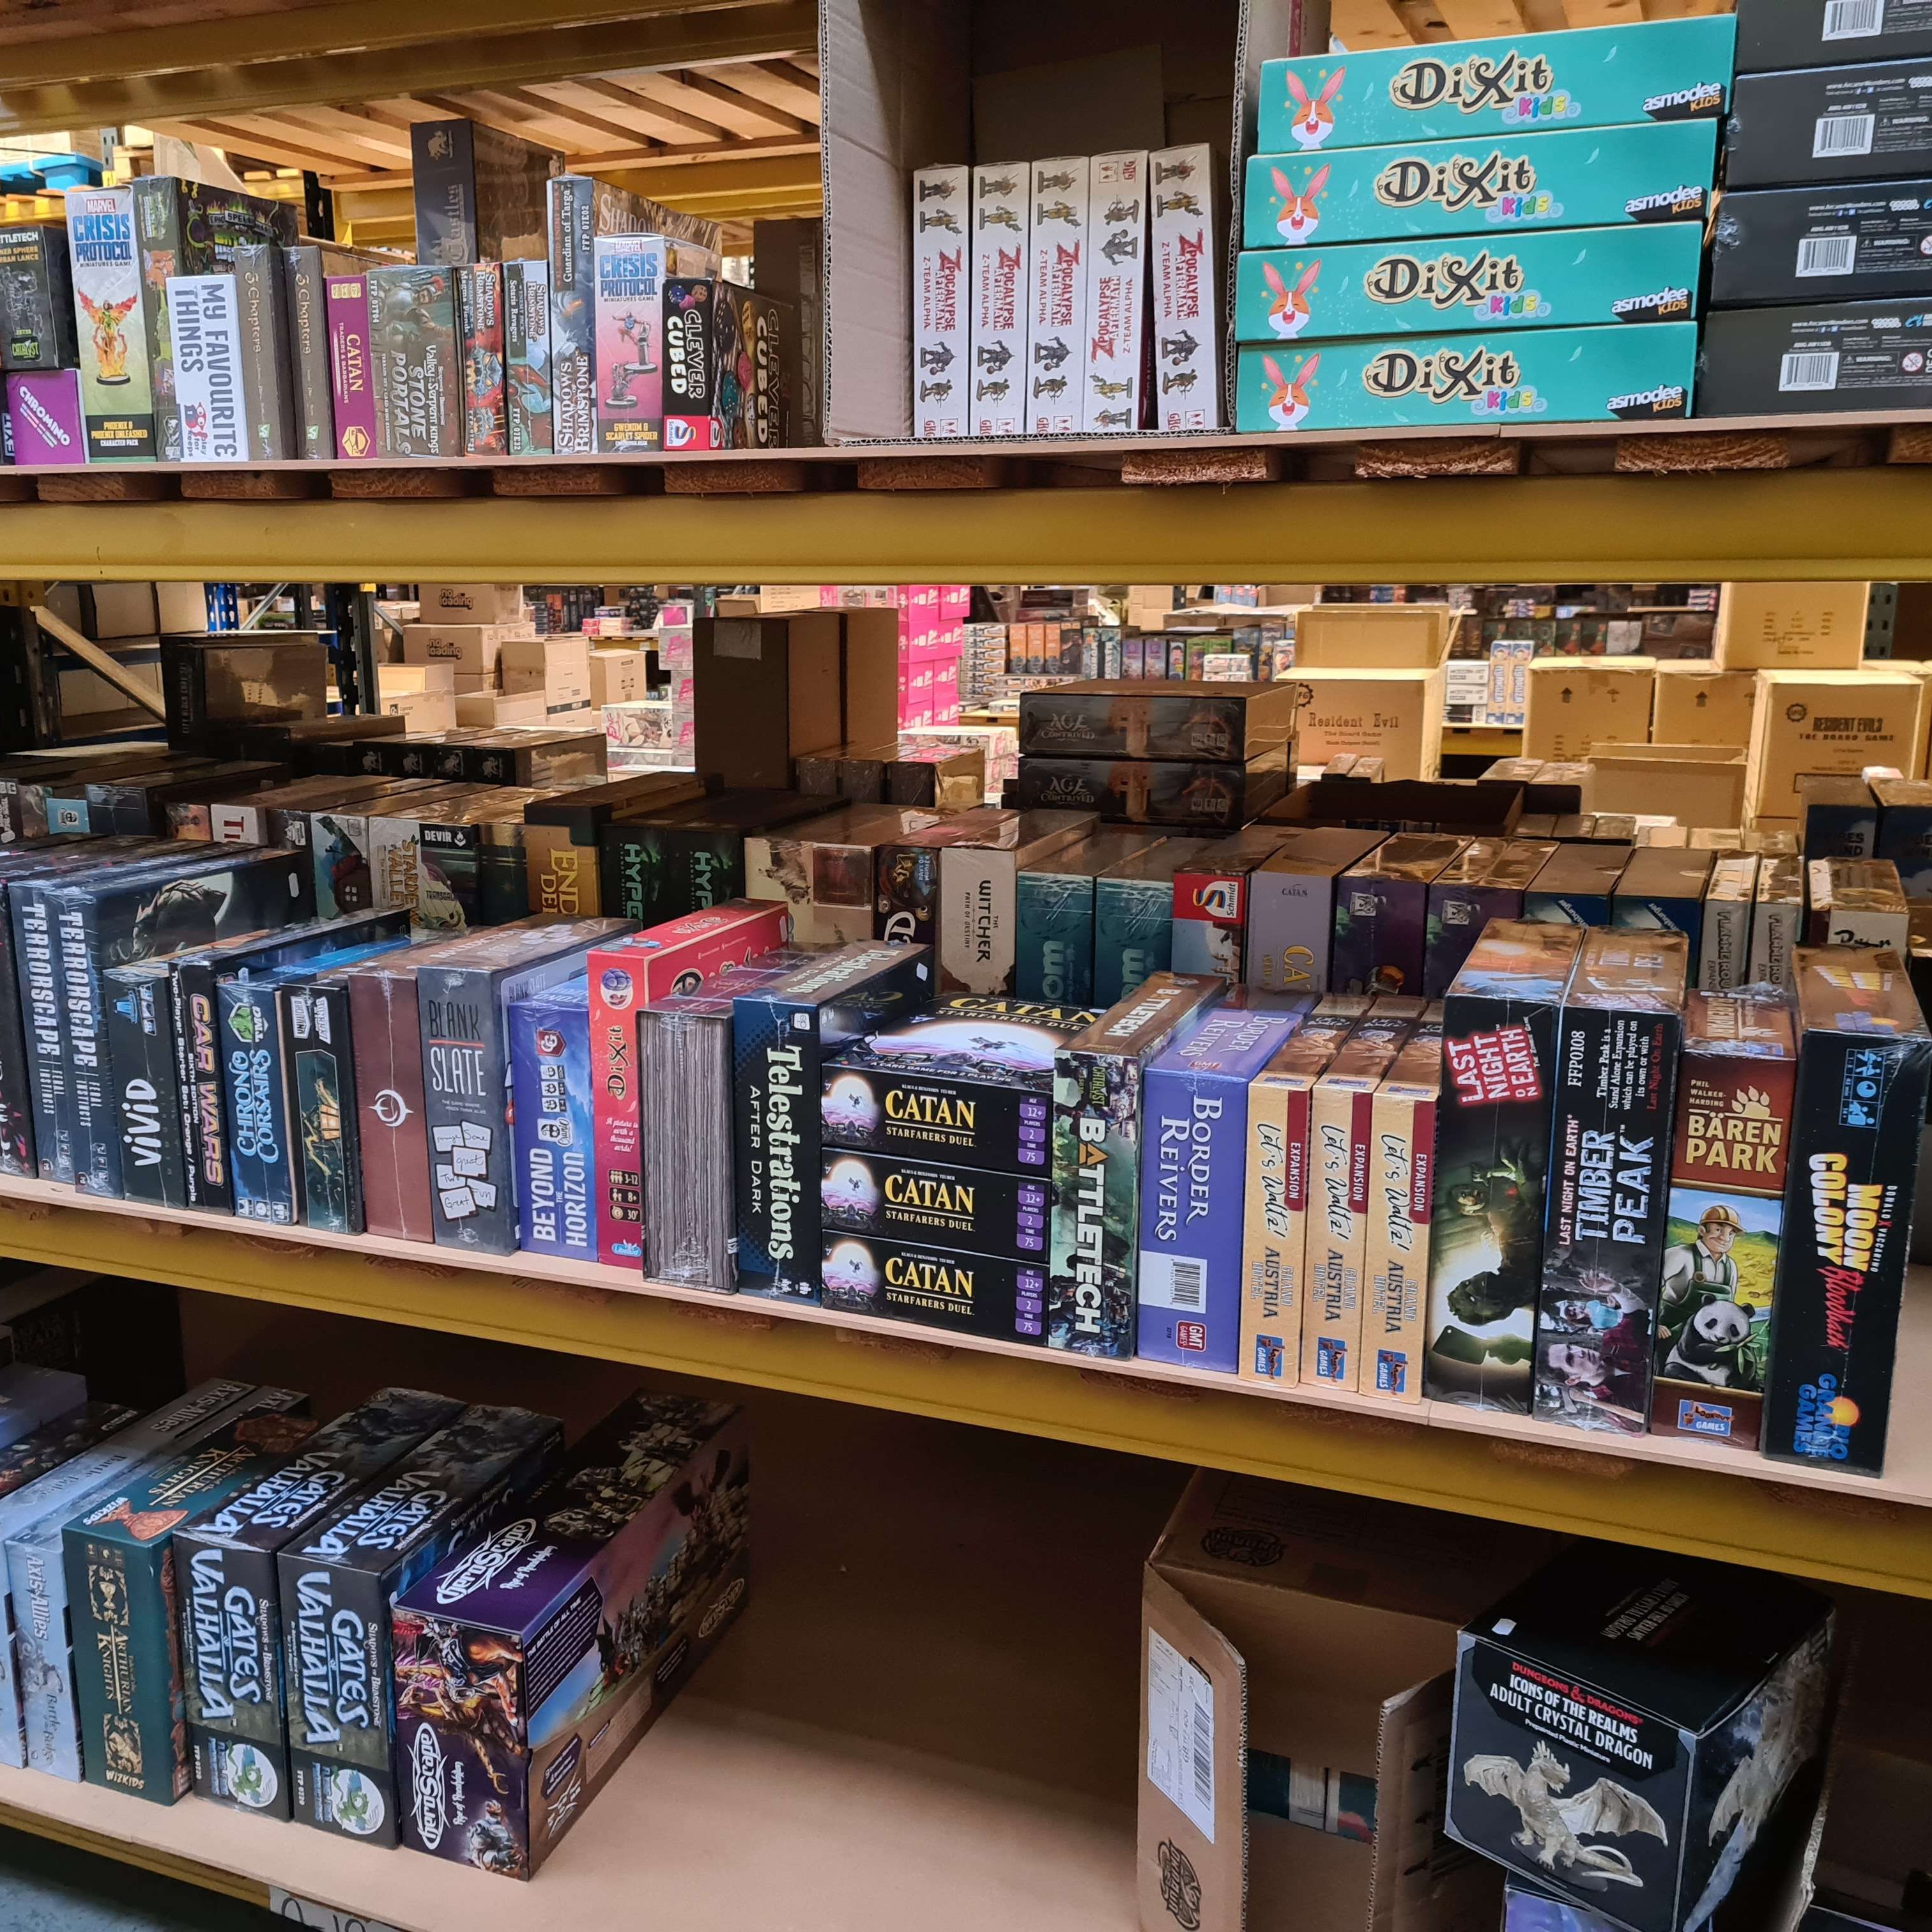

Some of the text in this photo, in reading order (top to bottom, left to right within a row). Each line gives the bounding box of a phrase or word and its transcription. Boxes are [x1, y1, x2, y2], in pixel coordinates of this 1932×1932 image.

[1643, 81, 1721, 112] asmodee
[1690, 94, 1721, 112] KIDS
[87, 199, 116, 213] MARVEL
[1625, 185, 1703, 215] asmodee
[73, 215, 130, 241] CRISIS
[581, 204, 590, 251] FFP 07E02
[562, 222, 574, 282] Guardian of
[600, 253, 657, 279] CRISIS
[601, 279, 657, 296] PROTOCOL
[923, 256, 931, 297] Z-TEAM
[1611, 286, 1688, 314] asmodee
[175, 290, 204, 372] THINGS
[684, 309, 704, 399] CLEVER
[347, 334, 364, 392] CATAN
[668, 316, 687, 394] CUBED
[391, 350, 411, 455] PORTALS
[757, 316, 768, 443] CUBED
[19, 387, 70, 445] CHROMINO
[410, 365, 427, 441] STONE
[558, 362, 574, 447] SHADOWS
[575, 355, 590, 452] BRIMSTONE
[606, 431, 657, 440] SCARLET SPIDER
[439, 590, 455, 599] no
[439, 596, 473, 610] loading
[427, 639, 441, 648] no
[427, 646, 463, 659] loading
[1308, 712, 1399, 728] Resident Evil
[425, 830, 452, 843] DEVIR
[977, 880, 992, 962] WITCHER
[1227, 882, 1237, 917] Schmidt
[22, 903, 60, 1055] TERRORSCAPE
[59, 912, 97, 1068] TERRORSCAPE
[172, 971, 183, 1036] Two-Player
[429, 1000, 480, 1040] BLANK
[937, 1010, 1082, 1031] STARFARERS DUE
[1630, 1021, 1637, 1031] on
[177, 1038, 187, 1082] Starter
[1474, 1036, 1510, 1100] NIGHT
[1501, 1027, 1533, 1085] EARTH
[1568, 1031, 1585, 1087] FFP0108
[1599, 1045, 1609, 1063] Peak
[1609, 1020, 1625, 1108] Stand Alone Expansion
[1624, 1061, 1634, 1069] be
[1626, 1033, 1638, 1058] played
[1639, 1036, 1649, 1055] with
[1640, 1057, 1647, 1066] or
[1647, 1023, 1663, 1109] Last Night On Earth
[190, 993, 224, 1186] CAR WARS
[431, 1046, 487, 1096] SLATE
[967, 1073, 1011, 1082] PLAYERS
[1448, 1041, 1484, 1103] LAST
[1596, 1066, 1608, 1098] Timber
[1635, 1087, 1644, 1097] its
[1690, 1089, 1726, 1098] WALKER-
[229, 1050, 255, 1156] CHRONO
[249, 1049, 279, 1164] CORSAIRS
[885, 1091, 976, 1129] CATAN
[1027, 1107, 1042, 1117] 12+
[1621, 1086, 1632, 1110] which
[1689, 1098, 1724, 1107] HARDING
[749, 1085, 762, 1214] AFTER DARK
[886, 1126, 974, 1147] STARFARERS DUEL
[1688, 1112, 1781, 1146] BÄREN
[767, 1045, 803, 1261] Telestrations
[1026, 1153, 1036, 1162] 75
[1186, 1096, 1223, 1226] BORDER
[1289, 1142, 1301, 1199] EXPANSION
[1353, 1144, 1365, 1200] EXPANSION
[1685, 1138, 1779, 1174] PARK
[188, 1164, 197, 1202] Purple
[530, 1149, 556, 1242] BEYOND
[565, 1152, 587, 1248] HORIZON
[885, 1175, 974, 1214] CATAN
[1257, 1123, 1288, 1239] Let's Waltz!
[1413, 1153, 1427, 1211] EXPANSION
[1559, 1117, 1579, 1246] LAST NIGHT ON EARTH
[1575, 1130, 1615, 1241] TIMBER
[1613, 1135, 1653, 1243] PEAK
[1884, 1185, 1897, 1220] DONALD
[885, 1211, 973, 1231] STARFARERS DUEL
[1075, 1117, 1108, 1335] BATTLETECH
[1809, 1153, 1848, 1265] COLONY
[1843, 1184, 1883, 1272] MOON
[1025, 1238, 1034, 1246] 75
[1870, 1227, 1890, 1273] VACCARINO
[1250, 1261, 1263, 1299] HOTEL
[1263, 1246, 1281, 1318] AUSTRIA
[1281, 1266, 1294, 1307] GRAND
[1324, 1248, 1344, 1321] AUSTRIA
[1385, 1259, 1404, 1333] AUSTRIA
[886, 1292, 972, 1315] STARFARERS DUEL
[1189, 1324, 1204, 1349] GMT
[1793, 1384, 1817, 1453] GAMES
[1828, 1426, 1850, 1459] RIO
[96, 1632, 114, 1699] KNIGHTS
[114, 1629, 132, 1713] ARTHURIAN
[1509, 1674, 1638, 1744] ICONS OF THE REALMS
[1512, 1662, 1643, 1725] DUNGEONS & DRAGONS
[1490, 1683, 1653, 1770] ADULT CRYSTAL DRAGON
[1524, 1719, 1611, 1763] Prepainted Plastic Miniature
[105, 1769, 144, 1789] WIZKIDS
